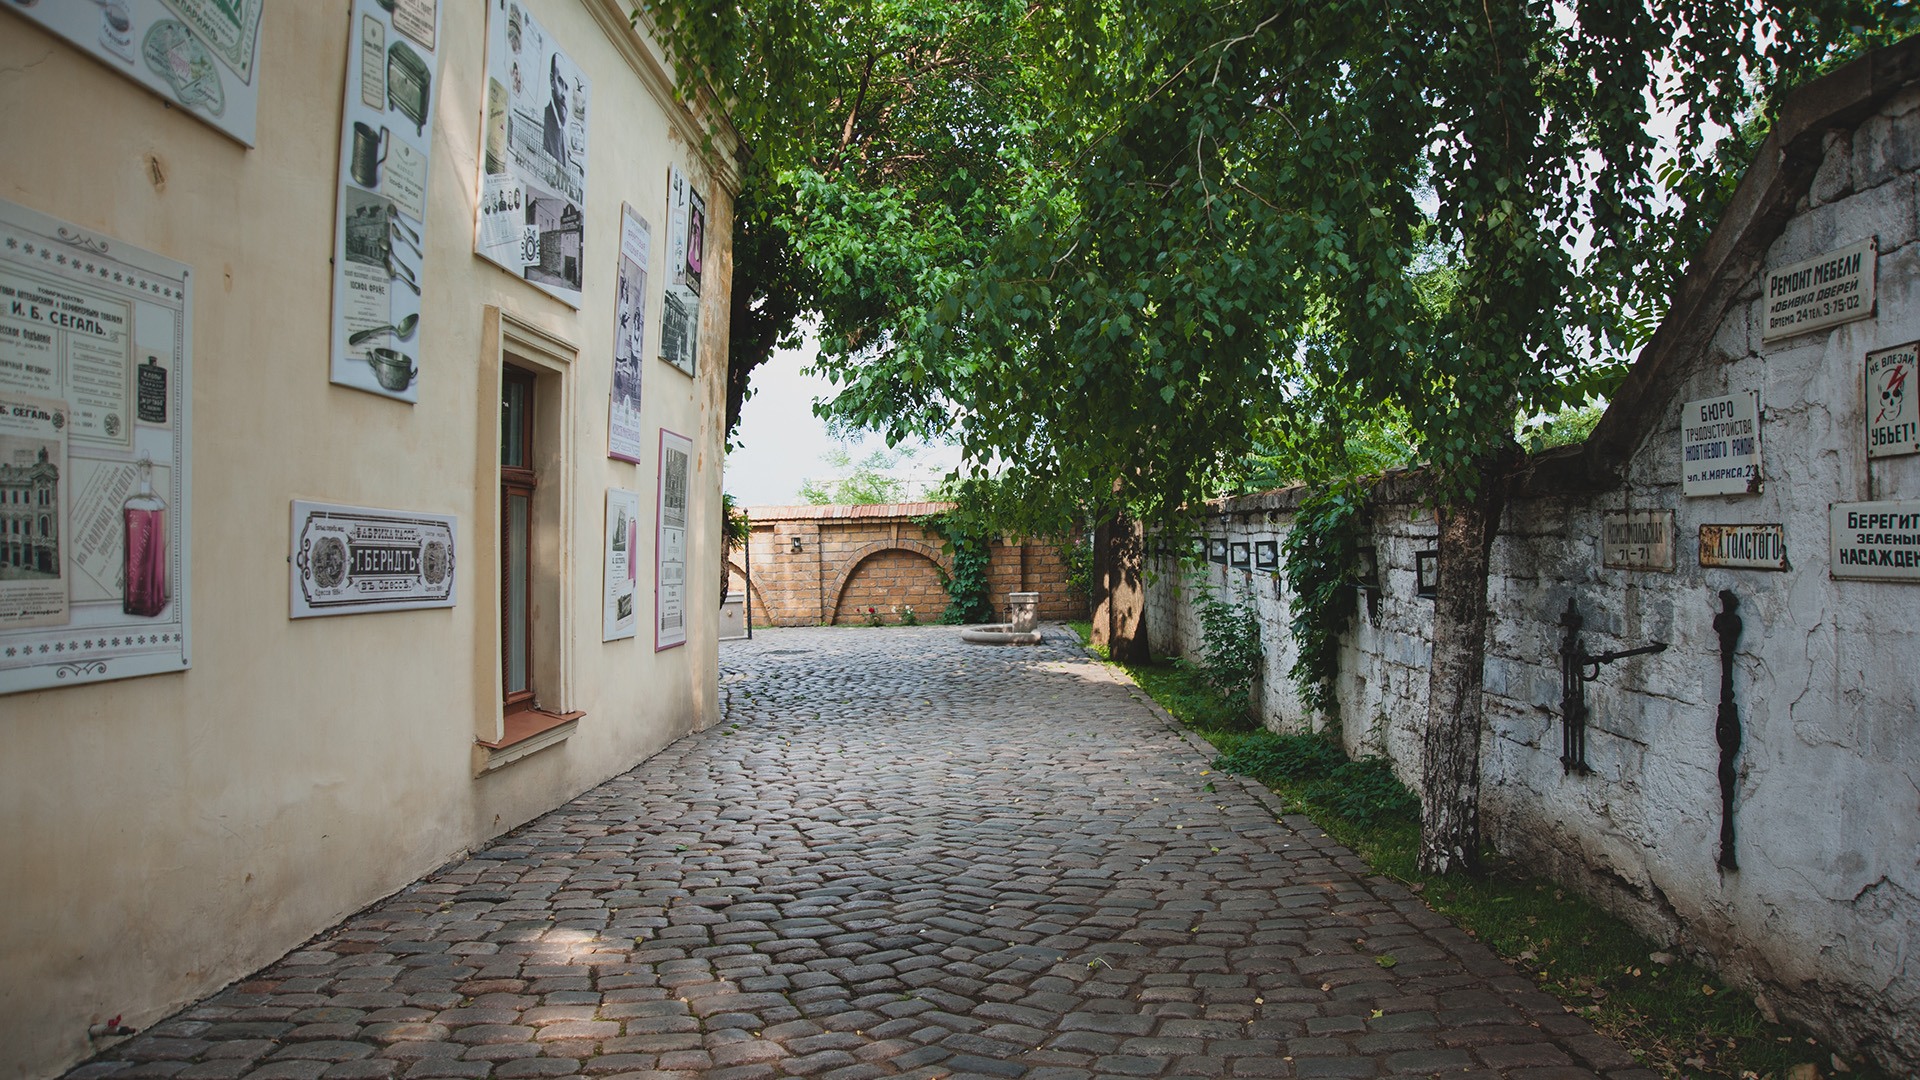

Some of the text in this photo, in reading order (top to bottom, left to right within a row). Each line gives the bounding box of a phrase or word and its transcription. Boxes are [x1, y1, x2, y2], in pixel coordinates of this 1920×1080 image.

[1770, 252, 1861, 298] РЕМОНТ МЕБЕЛИ
[1775, 291, 1815, 313] ОБИВКА
[1816, 276, 1859, 302] ДВЕРЕЙ
[12, 301, 106, 336] И. Б. СЕГАЛЬ.
[1796, 308, 1808, 323] 24
[1869, 361, 1879, 375] НЕ
[13, 407, 51, 420] СЕГАЛЬ
[1700, 400, 1734, 422] БЮРО
[1685, 419, 1752, 442] ТРУДОУСТРОЙСТВА
[1871, 422, 1915, 446] УБЬЕТ!
[1685, 436, 1755, 461] ЖОВТНЕВОГО РАЙОНА
[356, 526, 394, 540] ФАБРИКА
[1619, 547, 1650, 561] 71-71
